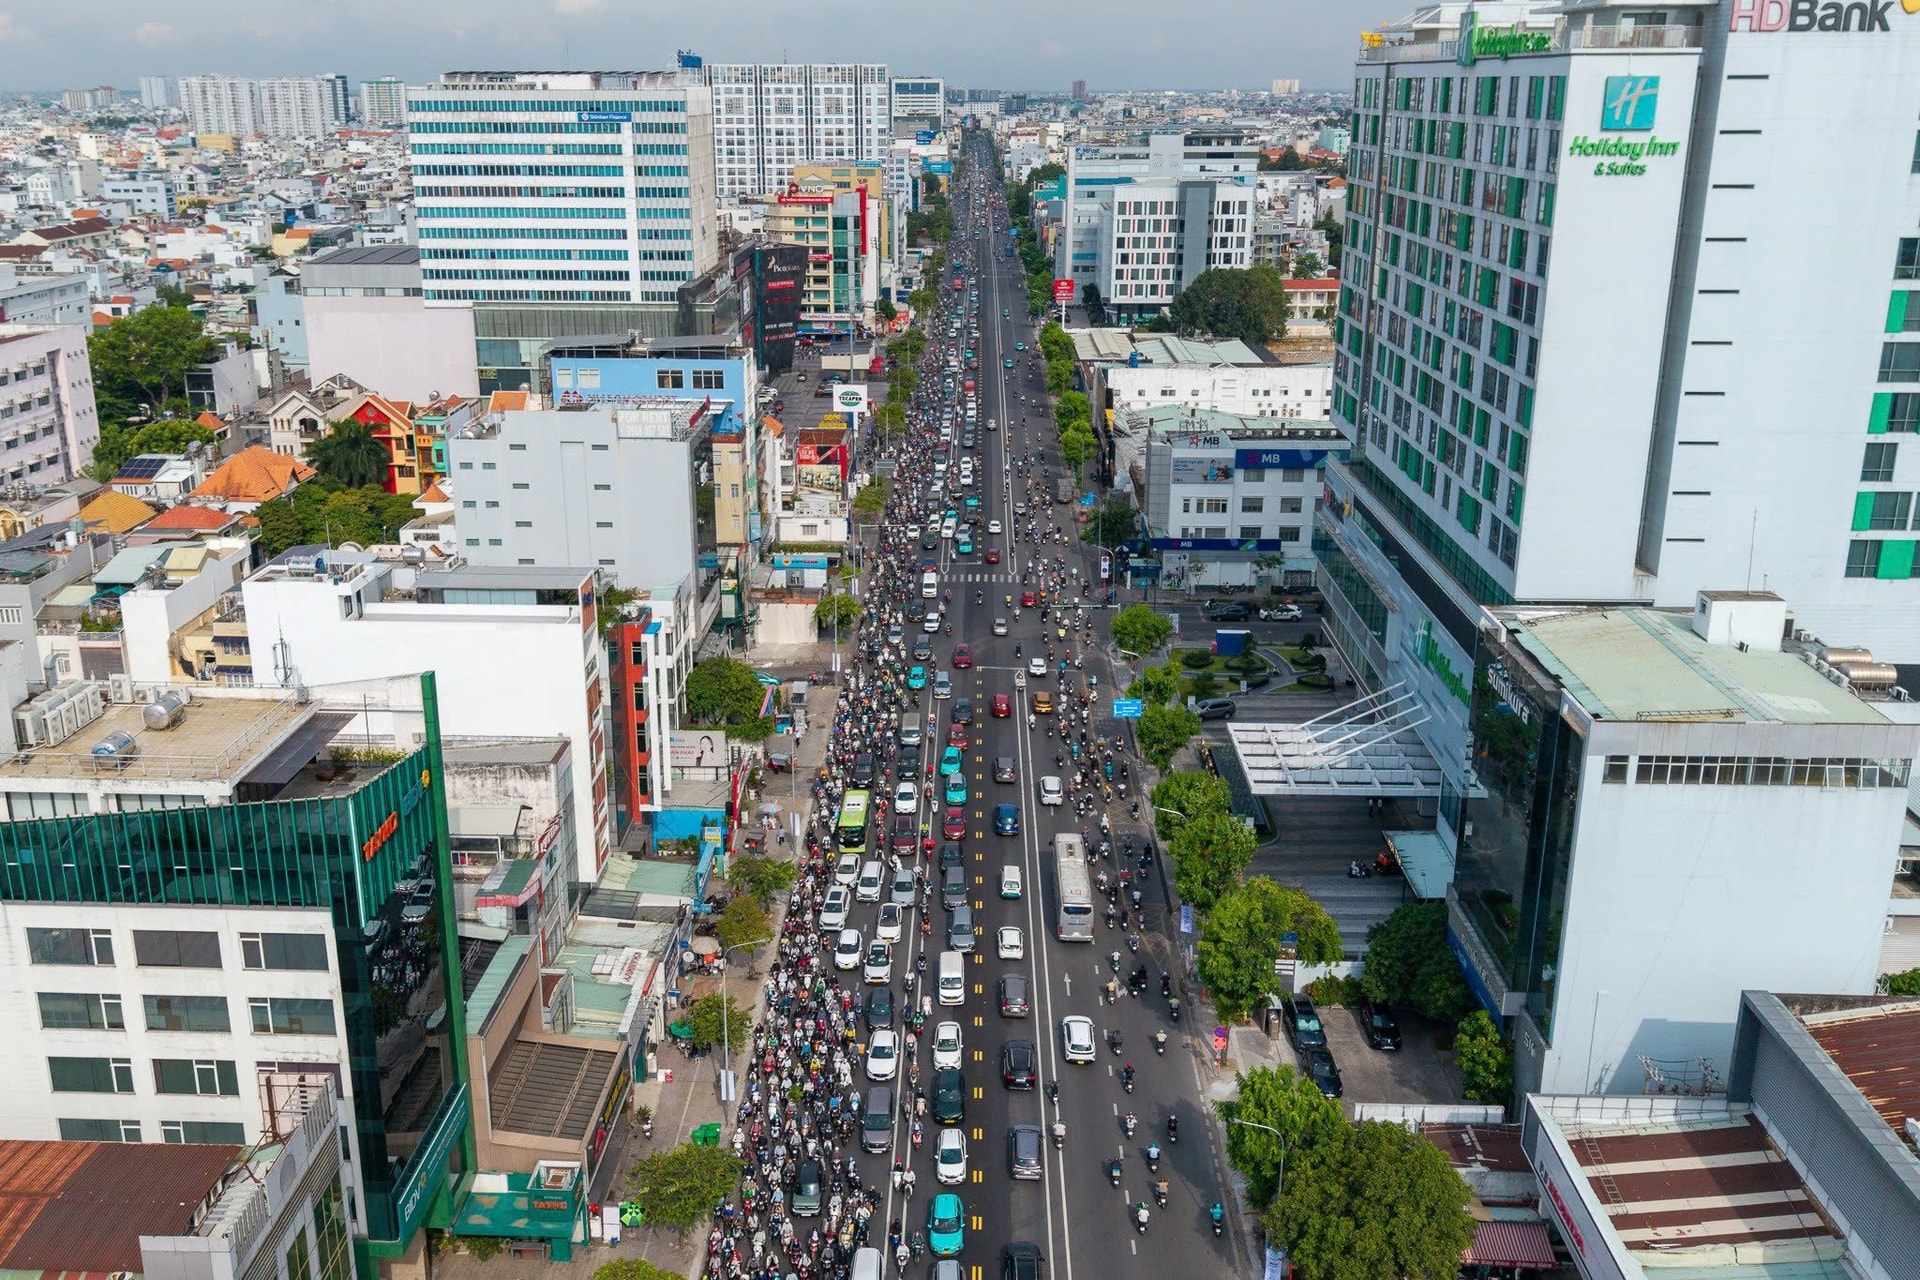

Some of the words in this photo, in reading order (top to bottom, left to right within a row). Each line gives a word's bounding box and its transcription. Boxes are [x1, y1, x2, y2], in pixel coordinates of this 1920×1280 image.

[1729, 0, 1894, 32] HDBank
[1569, 136, 1646, 160] Holiday
[1647, 136, 1680, 157] Inn
[1594, 163, 1604, 176] &
[1605, 163, 1647, 176] Suites
[642, 412, 668, 424] RENT
[1203, 436, 1220, 445] MB
[1261, 454, 1280, 464] MB
